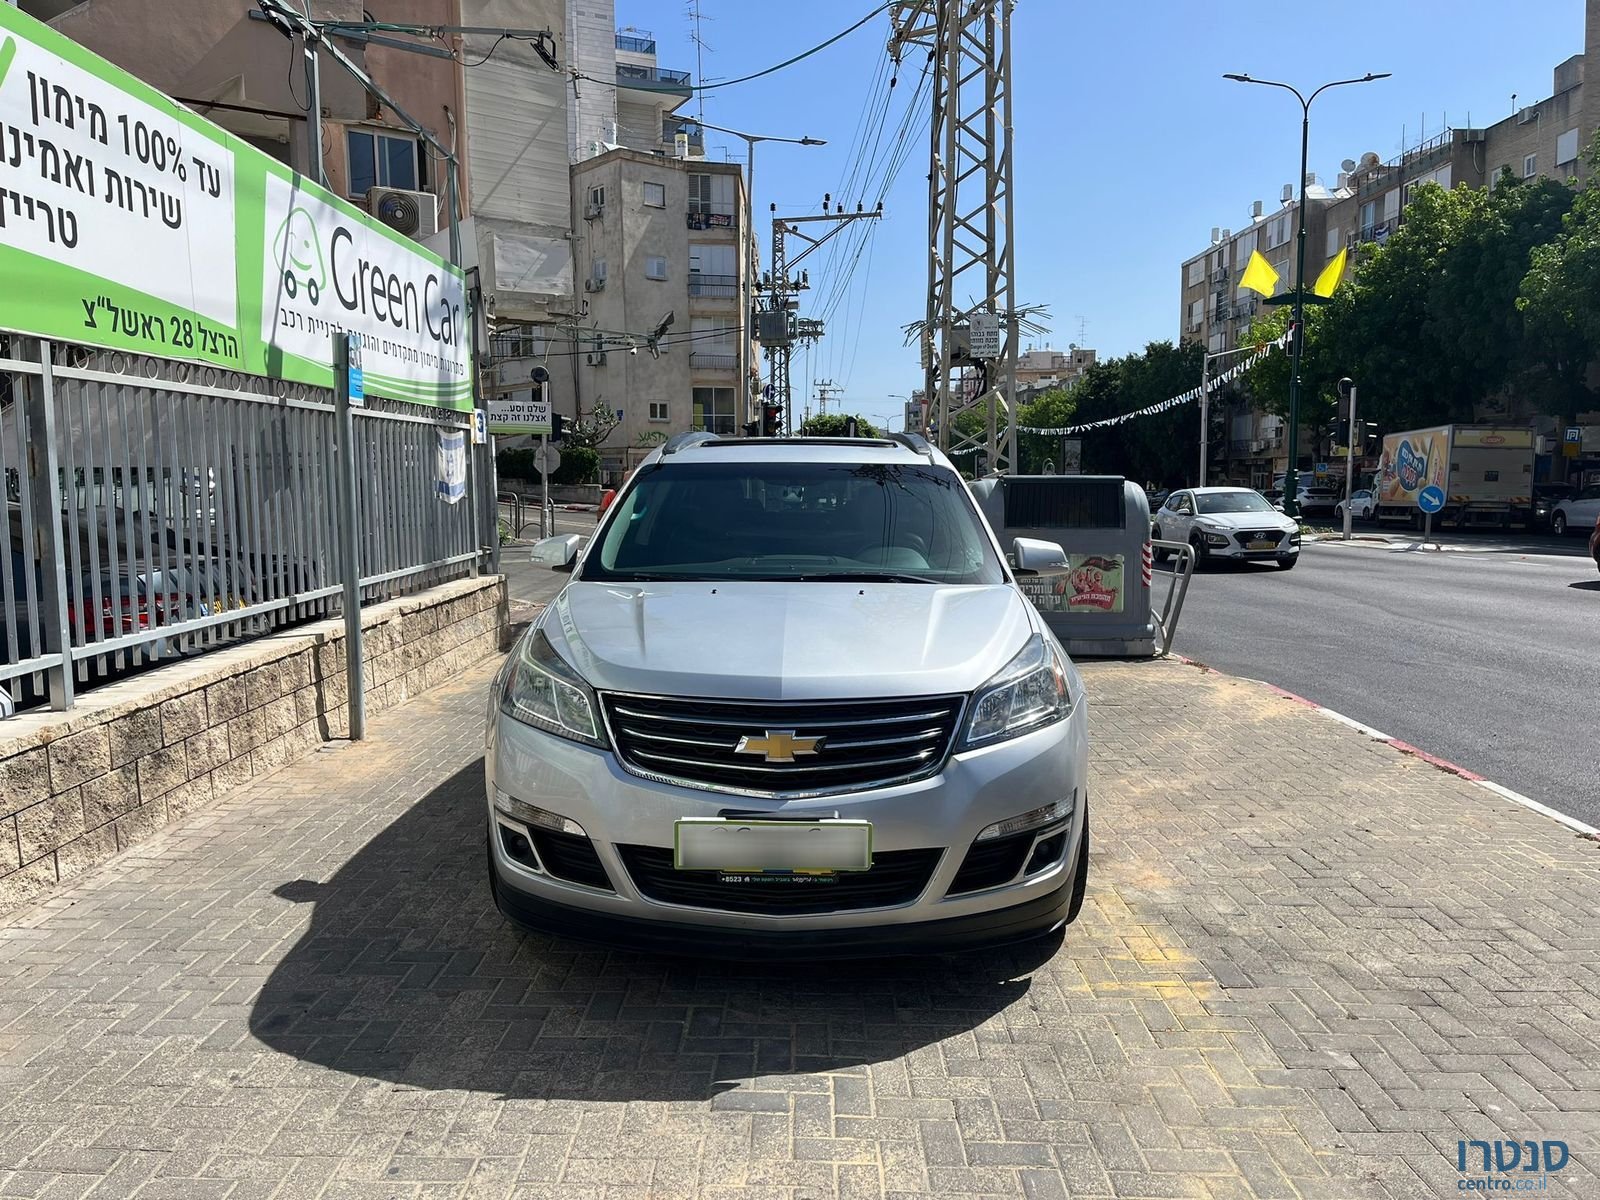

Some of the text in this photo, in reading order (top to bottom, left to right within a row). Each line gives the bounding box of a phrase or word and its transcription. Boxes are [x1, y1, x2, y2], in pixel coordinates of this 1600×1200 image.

[27, 70, 221, 198] עד 100% מימון
[104, 167, 182, 230] שירות
[330, 226, 460, 348] Green Car
[280, 308, 303, 331] רכב
[171, 316, 193, 350] 28
[198, 321, 239, 359] הרצל
[383, 340, 418, 364] מתקדמים
[420, 351, 438, 368] מימון
[490, 413, 508, 423] קצת
[523, 413, 546, 422] אצלנו
[527, 403, 546, 412] שלם
